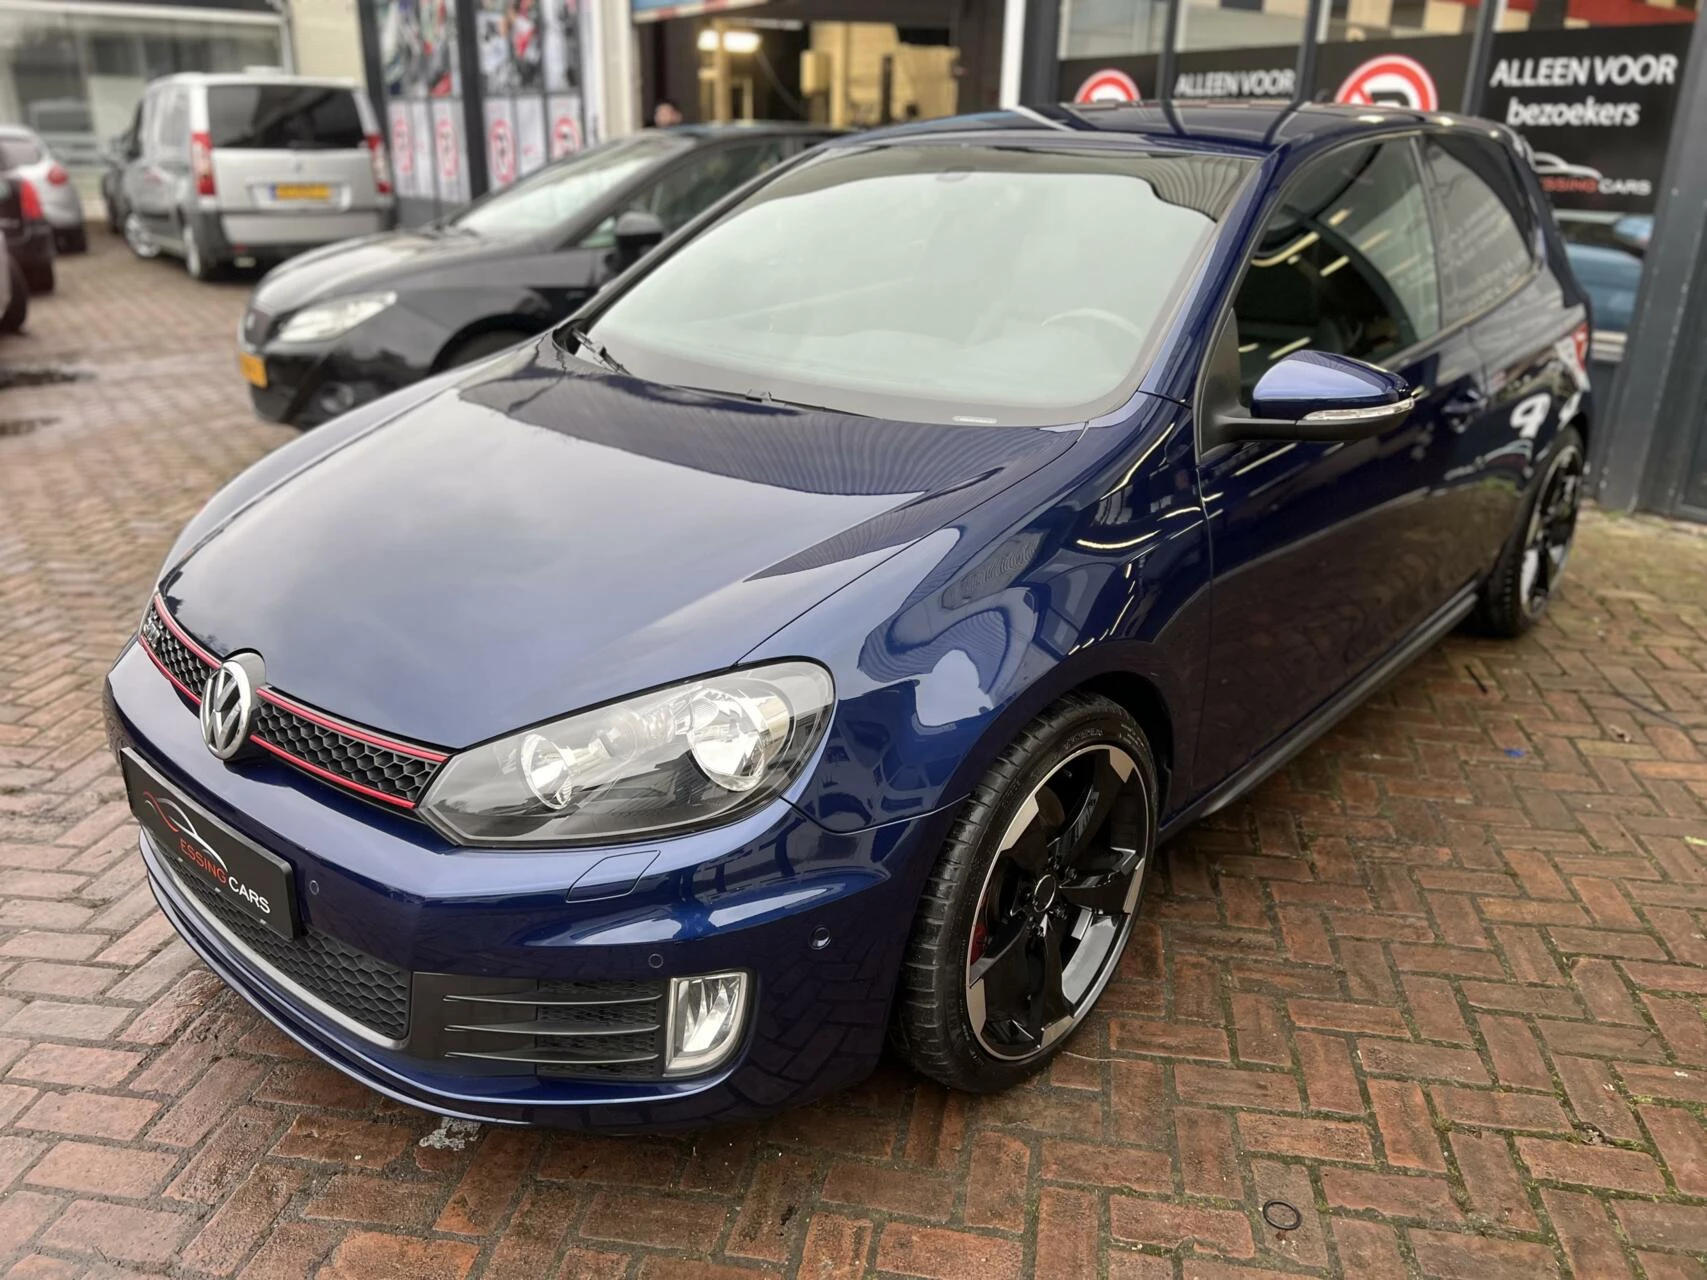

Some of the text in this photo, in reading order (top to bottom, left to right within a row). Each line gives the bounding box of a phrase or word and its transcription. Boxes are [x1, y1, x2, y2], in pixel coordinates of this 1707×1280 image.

[1174, 71, 1239, 97] ALLEEN
[1490, 53, 1678, 88] ALLEEN VOOR
[1506, 95, 1642, 126] bezoekers
[1598, 178, 1652, 196] CARS
[179, 838, 271, 914] ESSING CARS
